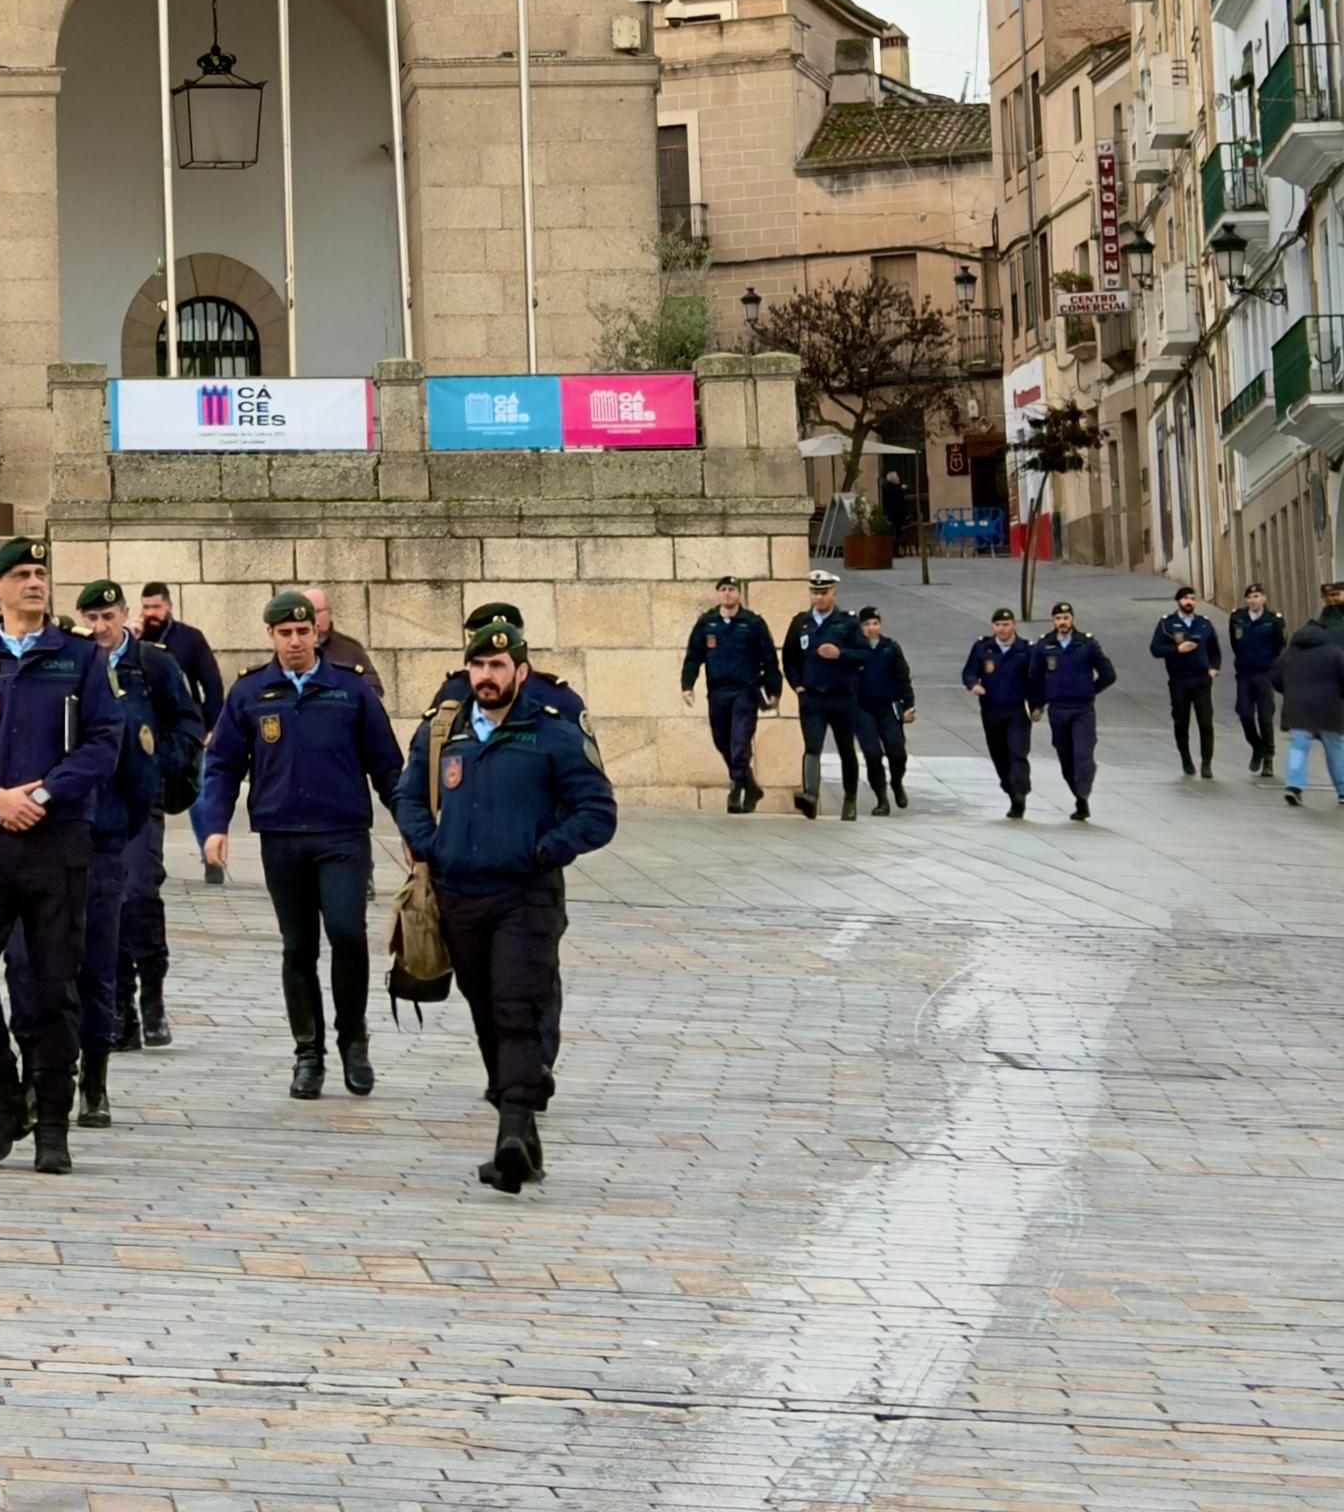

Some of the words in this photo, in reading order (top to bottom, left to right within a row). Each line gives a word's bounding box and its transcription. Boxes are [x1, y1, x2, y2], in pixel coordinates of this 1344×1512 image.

[1100, 158, 1119, 271] THOMSON
[1070, 293, 1117, 304] CENTRO
[1060, 302, 1126, 313] COMERCIAL
[237, 384, 272, 399] CÁ
[238, 401, 269, 413] CE
[238, 414, 286, 426] RES
